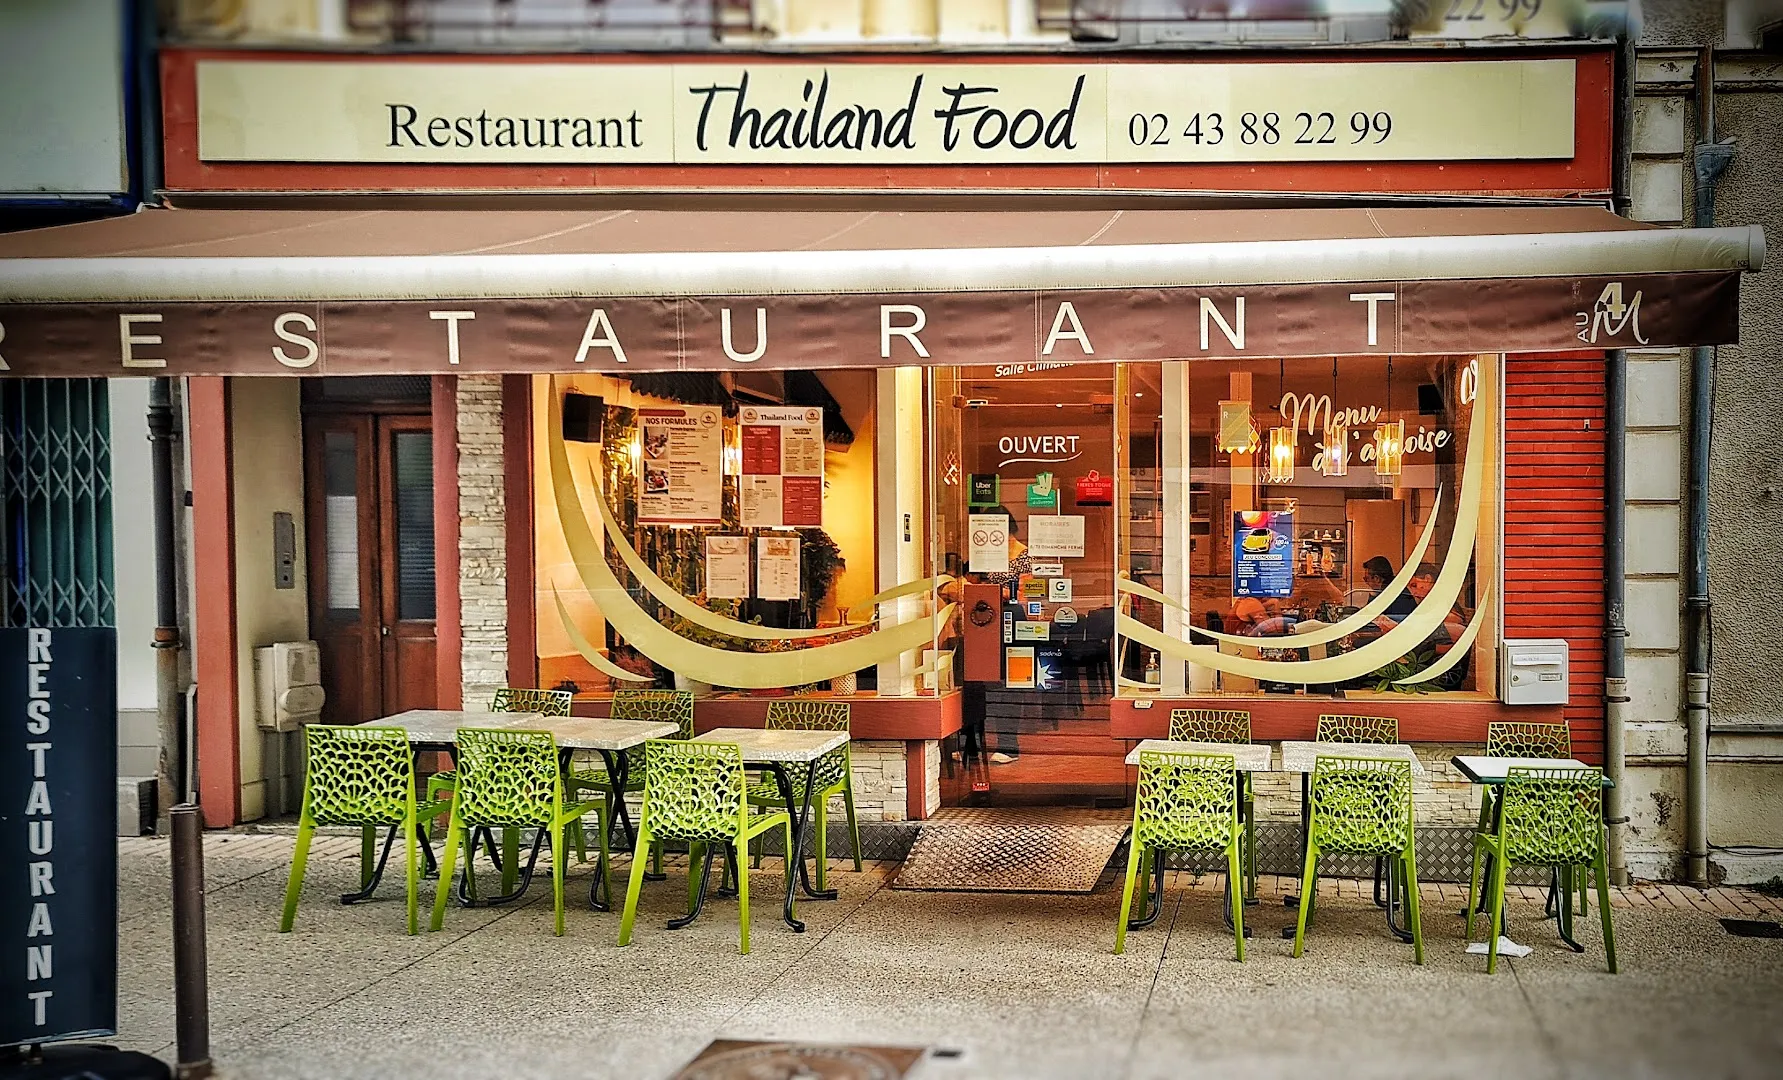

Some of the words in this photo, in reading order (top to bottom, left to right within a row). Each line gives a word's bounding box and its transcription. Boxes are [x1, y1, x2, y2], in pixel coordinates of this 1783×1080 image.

[385, 103, 643, 149] Restaurant
[689, 68, 924, 151] Thailand
[934, 72, 1086, 150] Food
[1128, 113, 1170, 146] 02
[1183, 112, 1224, 146] 43
[1240, 112, 1280, 145] 88
[1294, 112, 1337, 144] 22
[1350, 111, 1392, 145] 99
[0, 291, 1396, 371] ESTAURANT
[995, 363, 1024, 378] Salle
[645, 417, 660, 425] NOS
[661, 417, 698, 426] FORMULES
[1280, 391, 1381, 447] Menu
[999, 435, 1080, 454] OUVERT
[1055, 581, 1066, 591] G
[25, 627, 56, 1027] RESTAURANT
